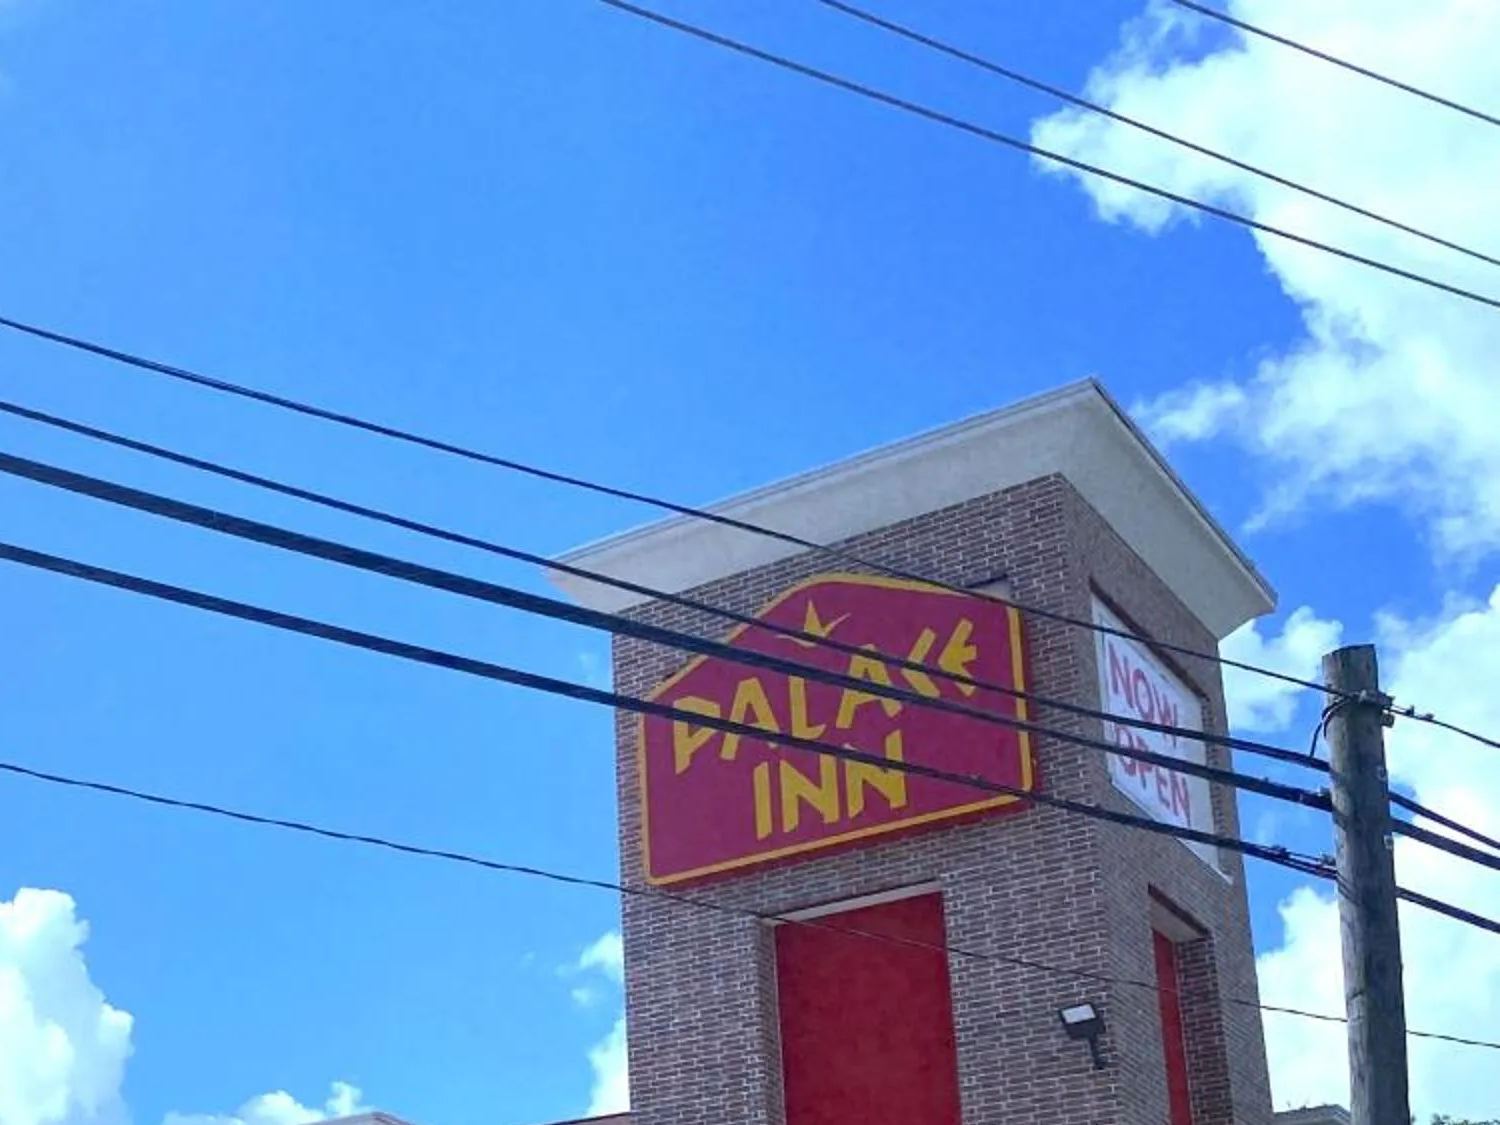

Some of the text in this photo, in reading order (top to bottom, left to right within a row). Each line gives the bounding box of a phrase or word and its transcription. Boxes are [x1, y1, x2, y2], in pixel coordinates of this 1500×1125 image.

[671, 618, 978, 775] PALACE
[1108, 641, 1178, 748] NOW
[752, 730, 907, 841] INN
[1115, 722, 1191, 828] OPEN
